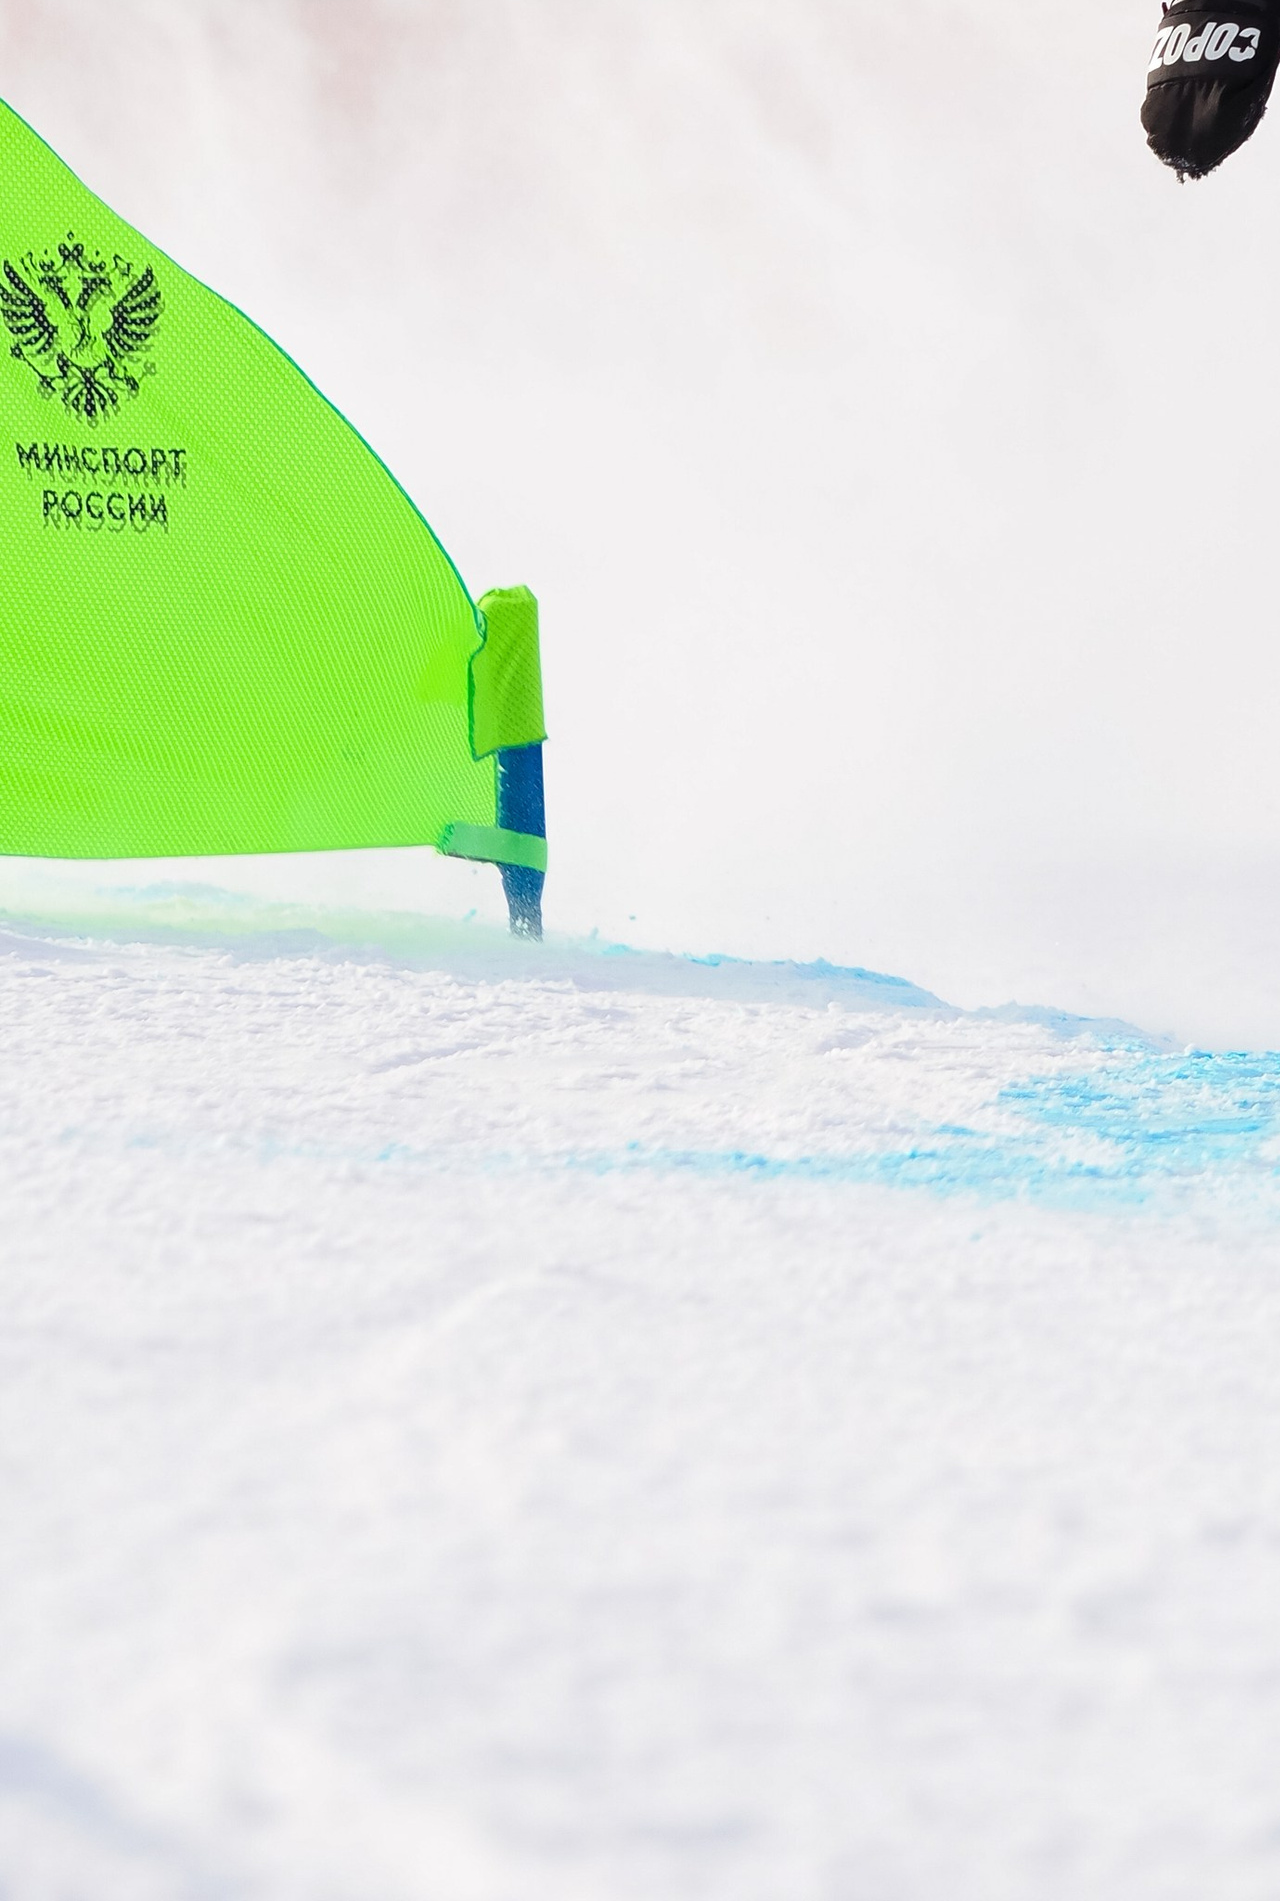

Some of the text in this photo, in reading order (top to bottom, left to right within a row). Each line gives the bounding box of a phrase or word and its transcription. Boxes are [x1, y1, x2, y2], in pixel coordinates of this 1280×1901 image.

[1149, 22, 1261, 70] COPOZ
[16, 442, 187, 478] МИНСПОРТ
[43, 489, 169, 525] РОССИИ
